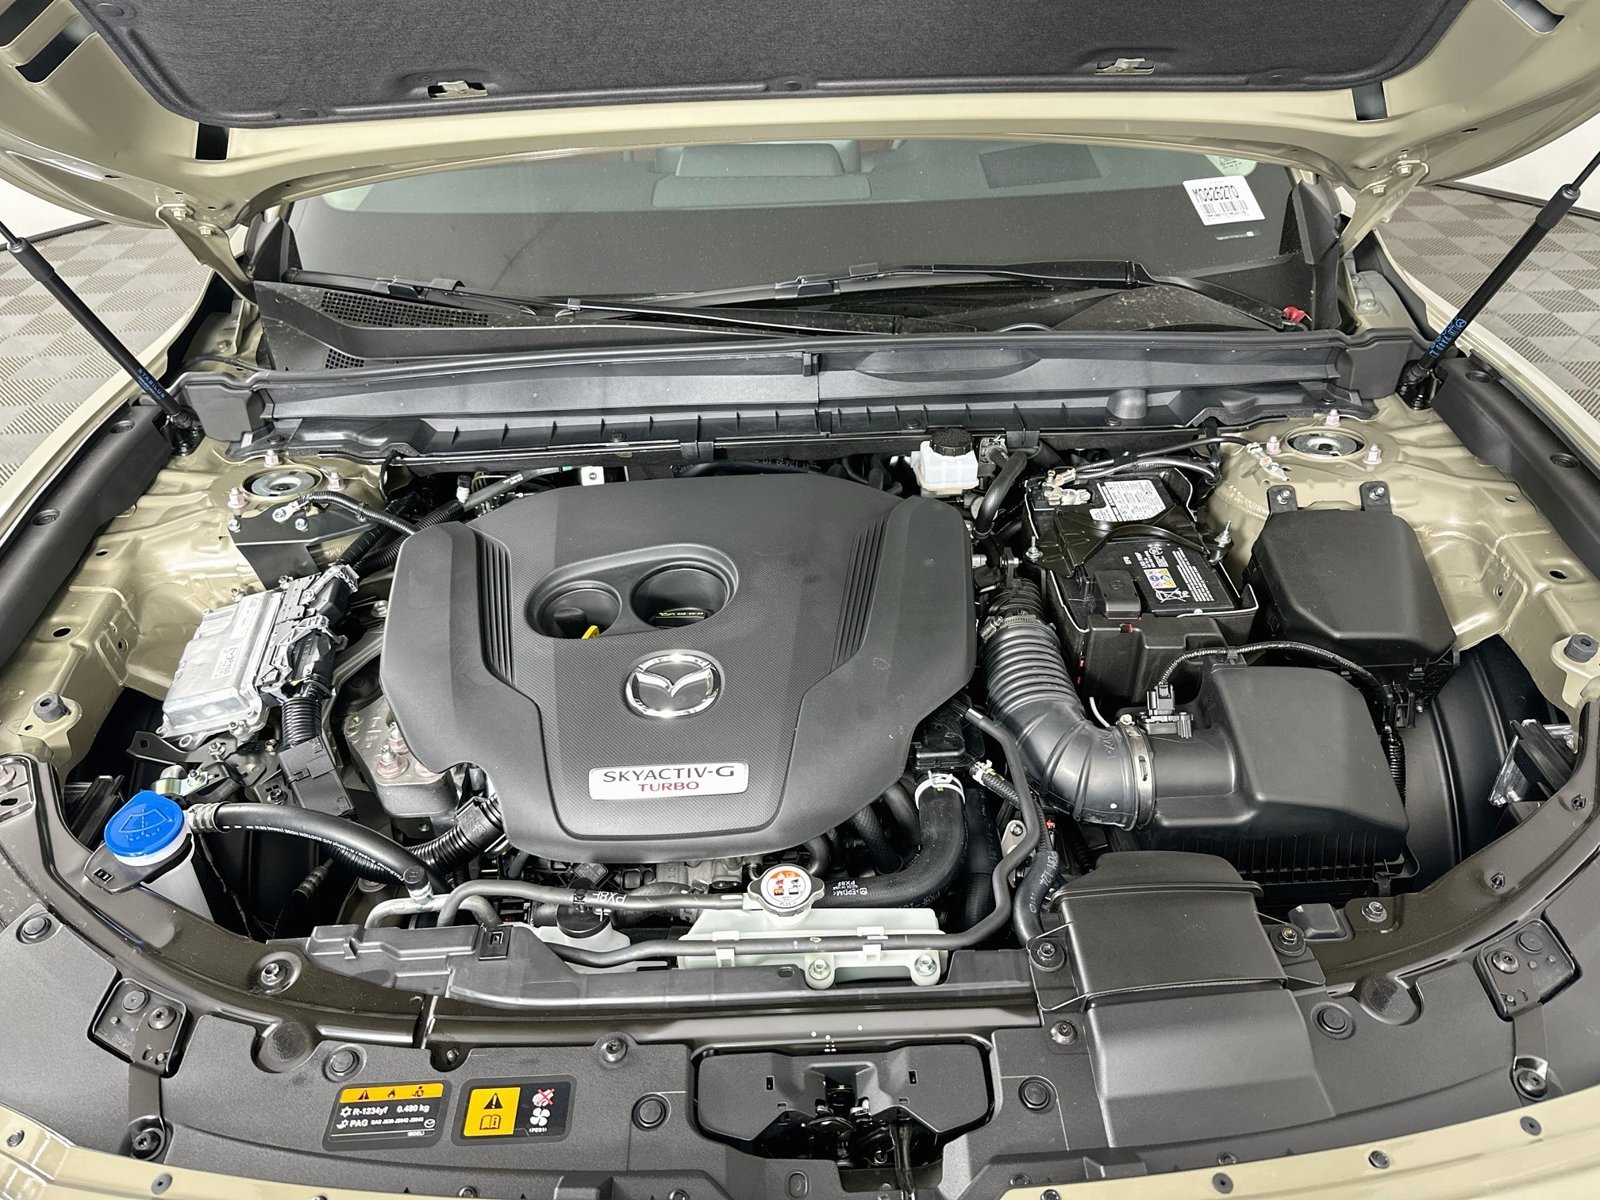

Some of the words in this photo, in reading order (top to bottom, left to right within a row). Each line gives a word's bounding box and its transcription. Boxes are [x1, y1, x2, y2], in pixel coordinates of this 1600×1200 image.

[602, 765, 735, 783] SKYACTIV-G
[638, 781, 700, 793] TURBO
[352, 1106, 389, 1116] R-1234yf
[419, 1104, 430, 1113] kg
[349, 1119, 369, 1128] PAG
